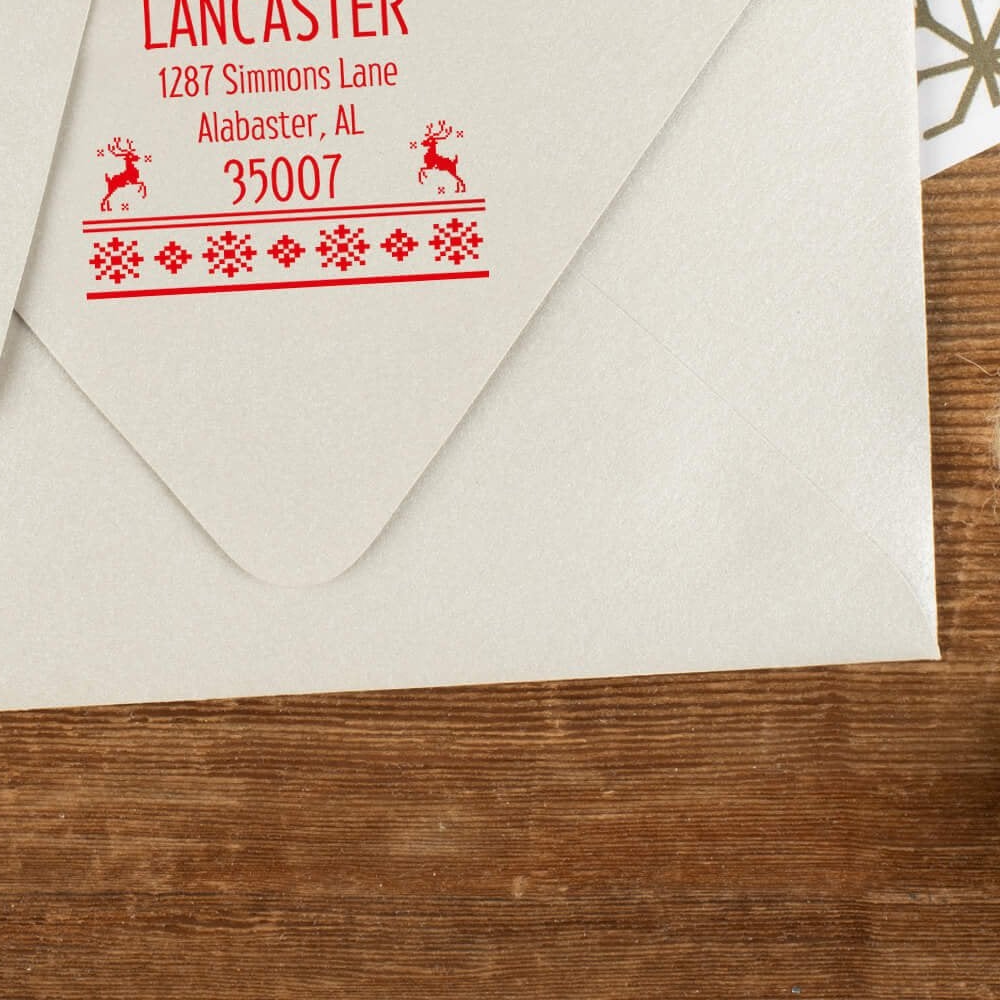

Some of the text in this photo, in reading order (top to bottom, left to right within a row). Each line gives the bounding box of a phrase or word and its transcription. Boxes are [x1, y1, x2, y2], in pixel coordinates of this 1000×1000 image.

[158, 57, 398, 98] 1287 Simmons Lane
[198, 104, 365, 144] Alabaster, AL
[223, 153, 342, 205] 35007
